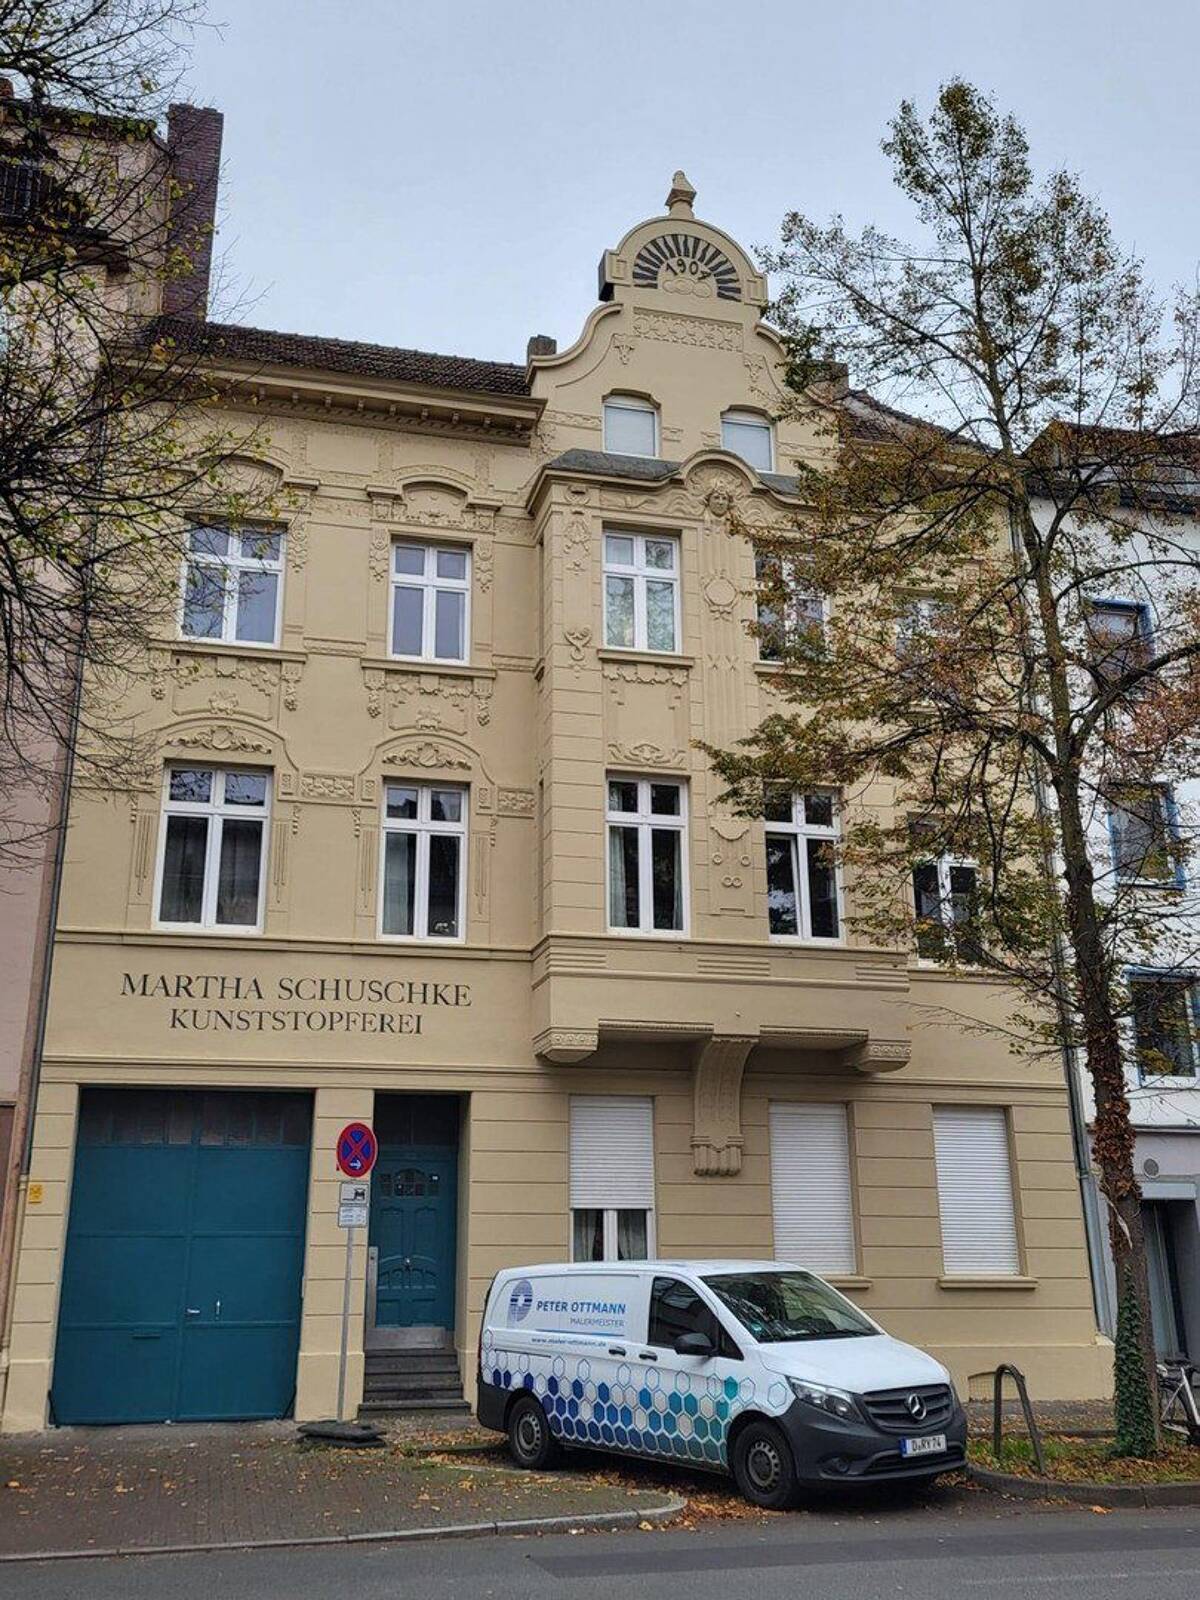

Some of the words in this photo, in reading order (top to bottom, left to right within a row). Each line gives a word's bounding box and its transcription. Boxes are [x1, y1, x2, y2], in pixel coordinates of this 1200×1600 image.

[666, 258, 712, 280] 1904
[120, 972, 264, 1000] MARTHA
[277, 977, 473, 1007] SCHUSCHKE
[169, 1008, 423, 1035] KUNSTSTOPFEREI
[536, 1301, 568, 1312] PETER
[571, 1302, 626, 1314] OTTMANN
[569, 1317, 625, 1327] MALERMEISTER
